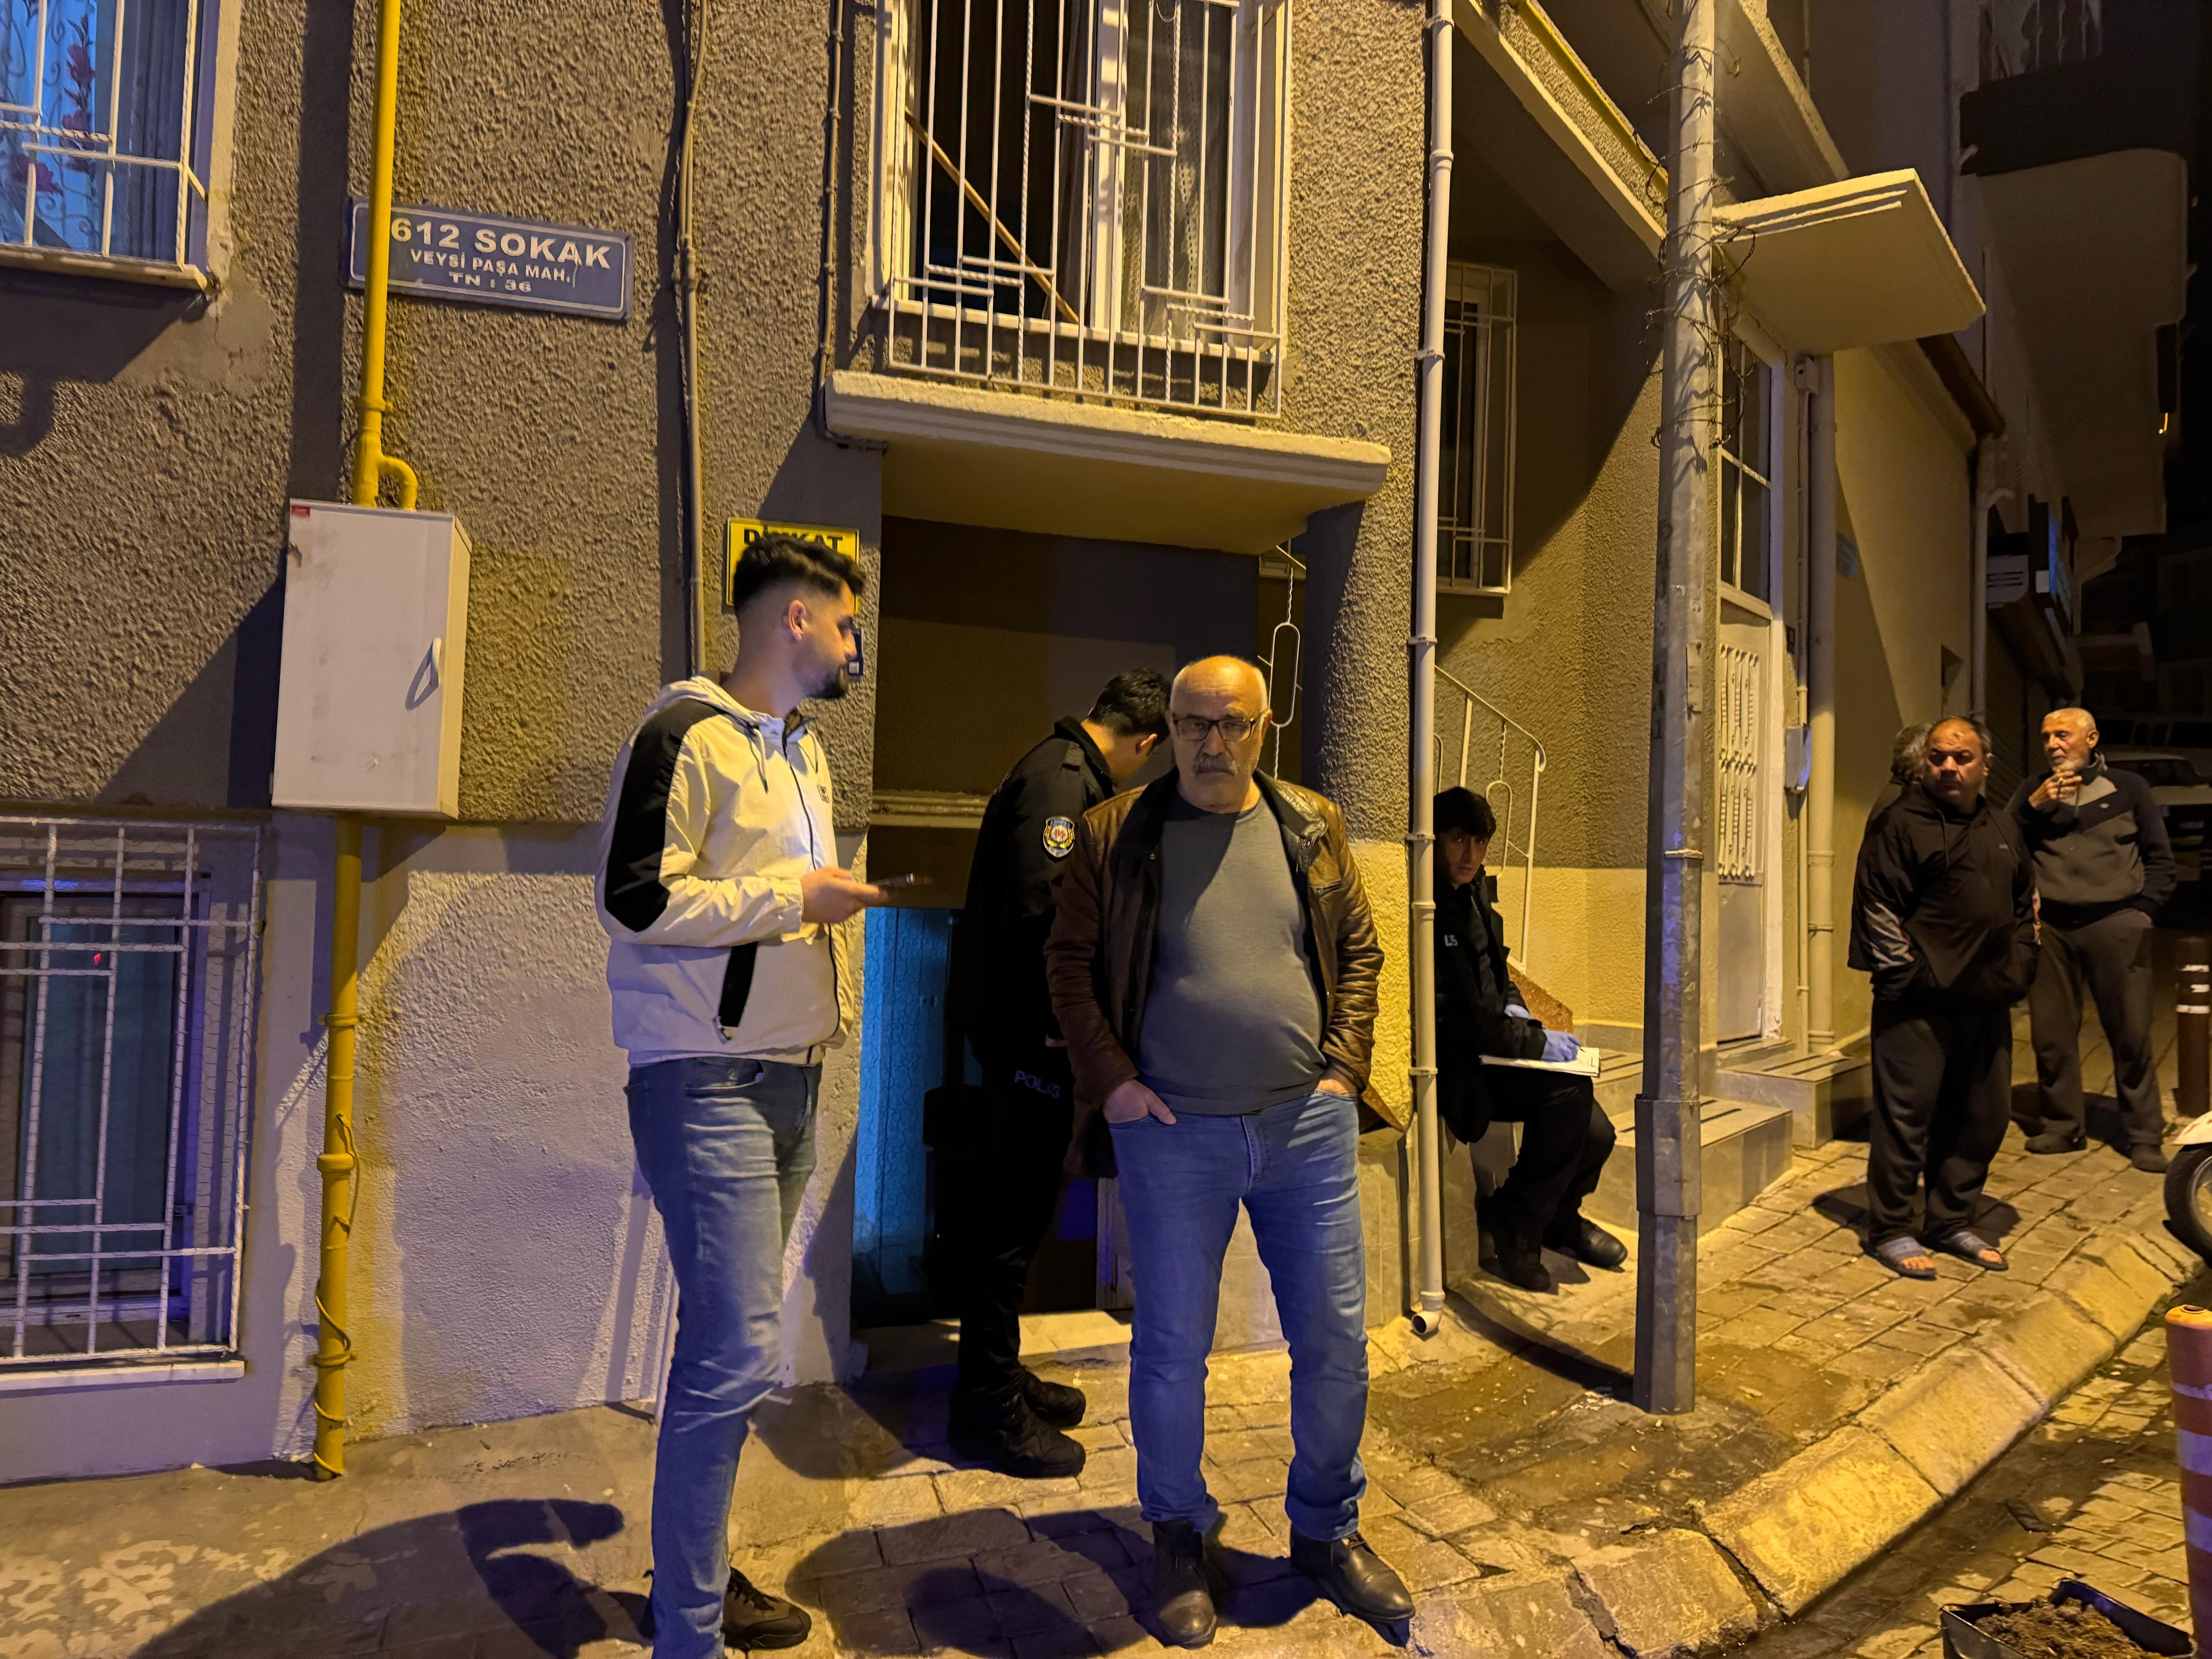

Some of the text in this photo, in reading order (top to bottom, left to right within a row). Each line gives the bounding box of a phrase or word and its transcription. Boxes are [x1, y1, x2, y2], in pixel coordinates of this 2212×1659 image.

[410, 248, 570, 283] VEYSİ PAŞA MAH.
[474, 229, 611, 269] SOKAK
[449, 271, 480, 286] TN
